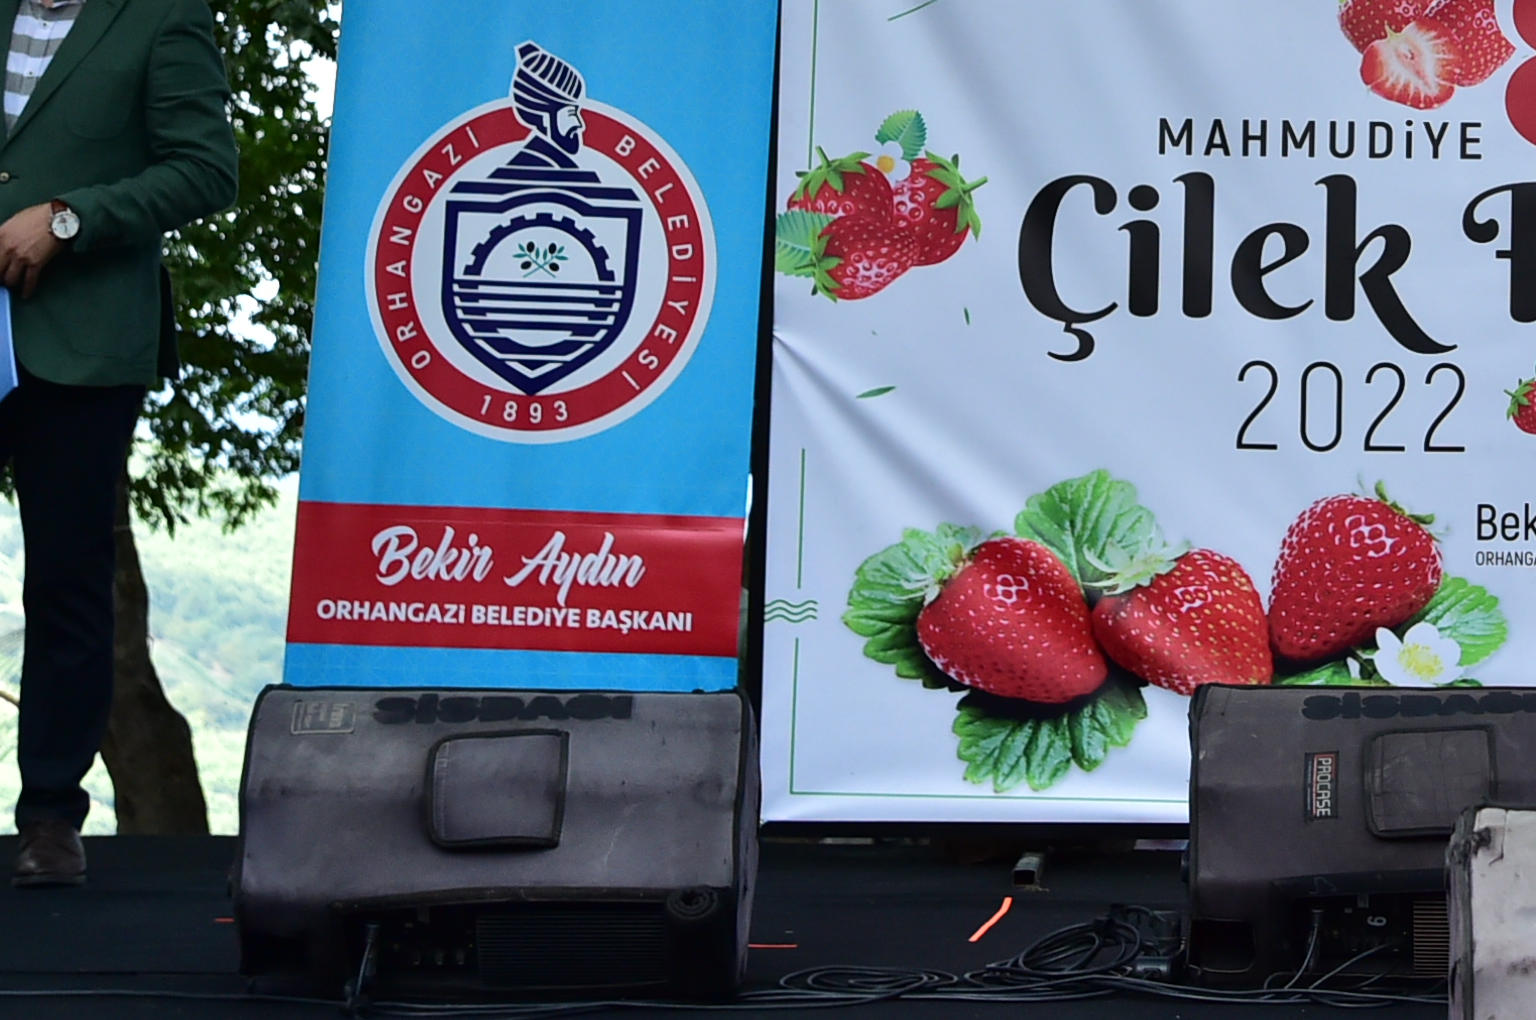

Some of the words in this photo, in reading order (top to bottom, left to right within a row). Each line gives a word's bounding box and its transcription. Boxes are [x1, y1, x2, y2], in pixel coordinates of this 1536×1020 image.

[385, 126, 480, 370] ORHANGAZİ
[1017, 171, 1459, 363] Çilek
[480, 393, 569, 424] 1893
[1235, 359, 1467, 454] 2022
[371, 525, 495, 587] Bekir
[503, 531, 647, 607] Aydın
[586, 608, 693, 635] BAŞKANI
[1316, 757, 1332, 818] PROCASE
